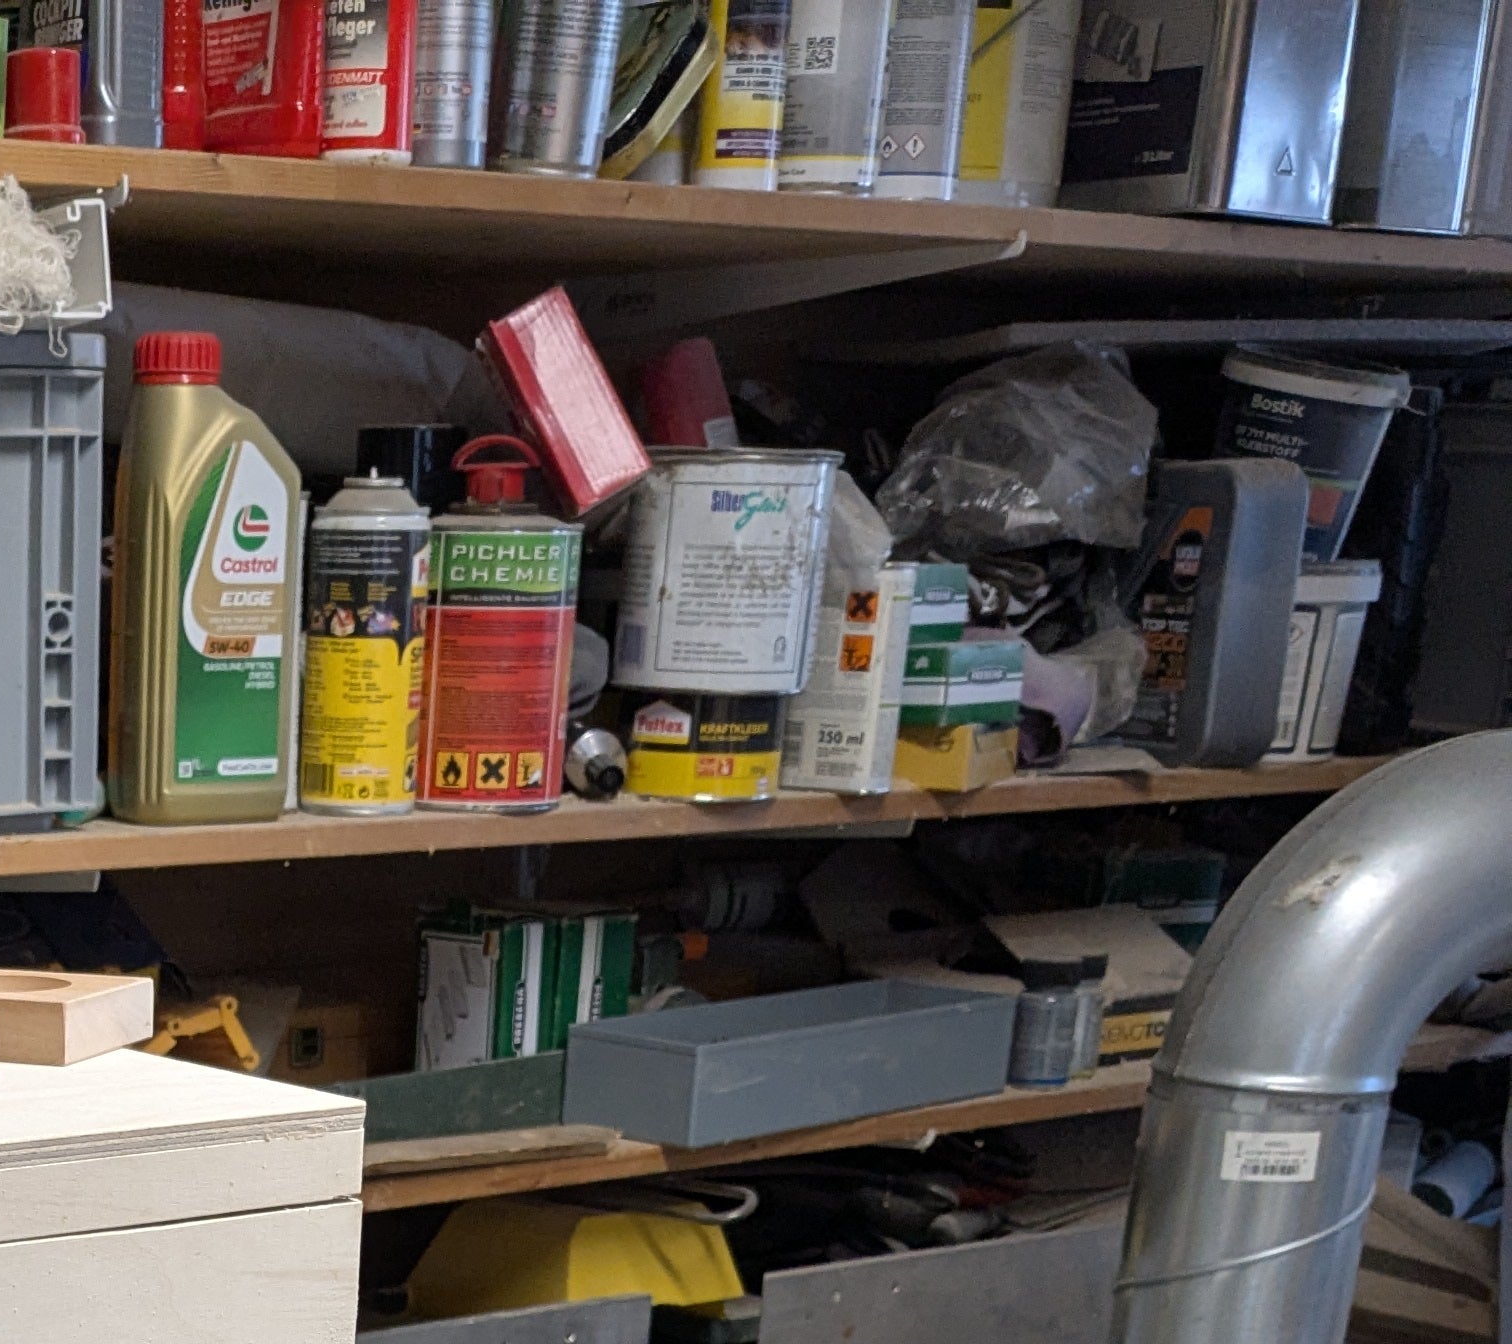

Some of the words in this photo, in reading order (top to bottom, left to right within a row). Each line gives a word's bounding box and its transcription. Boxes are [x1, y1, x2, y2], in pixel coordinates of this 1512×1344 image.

[327, 16, 377, 41] fleger
[1251, 393, 1306, 418] Bostik
[451, 544, 561, 561] PICHLER
[220, 557, 278, 574] Castrol
[450, 565, 560, 583] CHEMIE
[220, 591, 274, 607] EDGE
[209, 641, 250, 654] 5W-40
[817, 730, 843, 744] 250
[846, 731, 865, 745] ml
